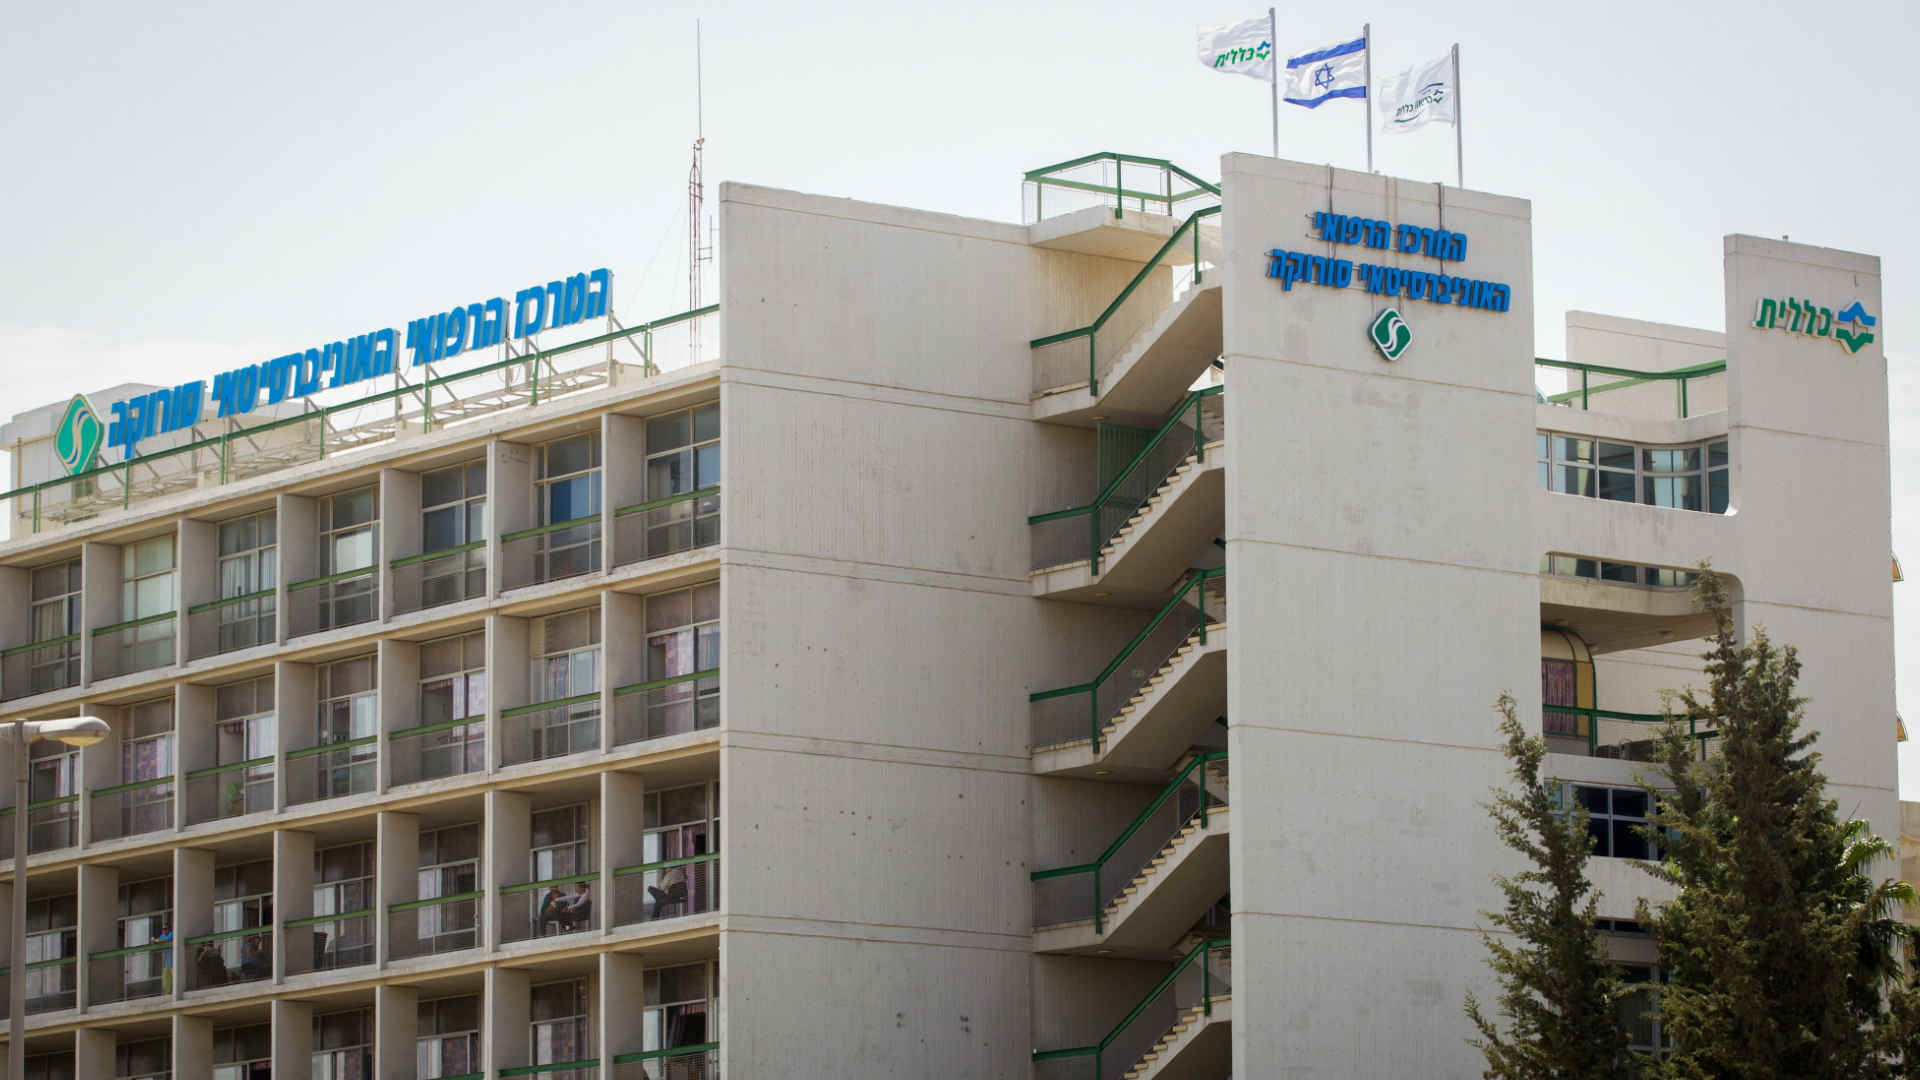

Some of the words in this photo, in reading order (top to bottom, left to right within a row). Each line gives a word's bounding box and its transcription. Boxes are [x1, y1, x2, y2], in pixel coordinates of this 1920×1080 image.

[1213, 47, 1255, 68] כללית
[1312, 211, 1391, 250] הרפואי
[1398, 213, 1468, 262] המרכז
[1267, 248, 1353, 292] סורוקה
[1359, 263, 1511, 313] האוניברסיטאי
[514, 267, 611, 340] המרכז
[1755, 296, 1831, 337] כללית
[406, 297, 508, 367] הרפואי
[211, 327, 398, 419] האוניברסיטאי
[107, 379, 205, 461] סורוקה
